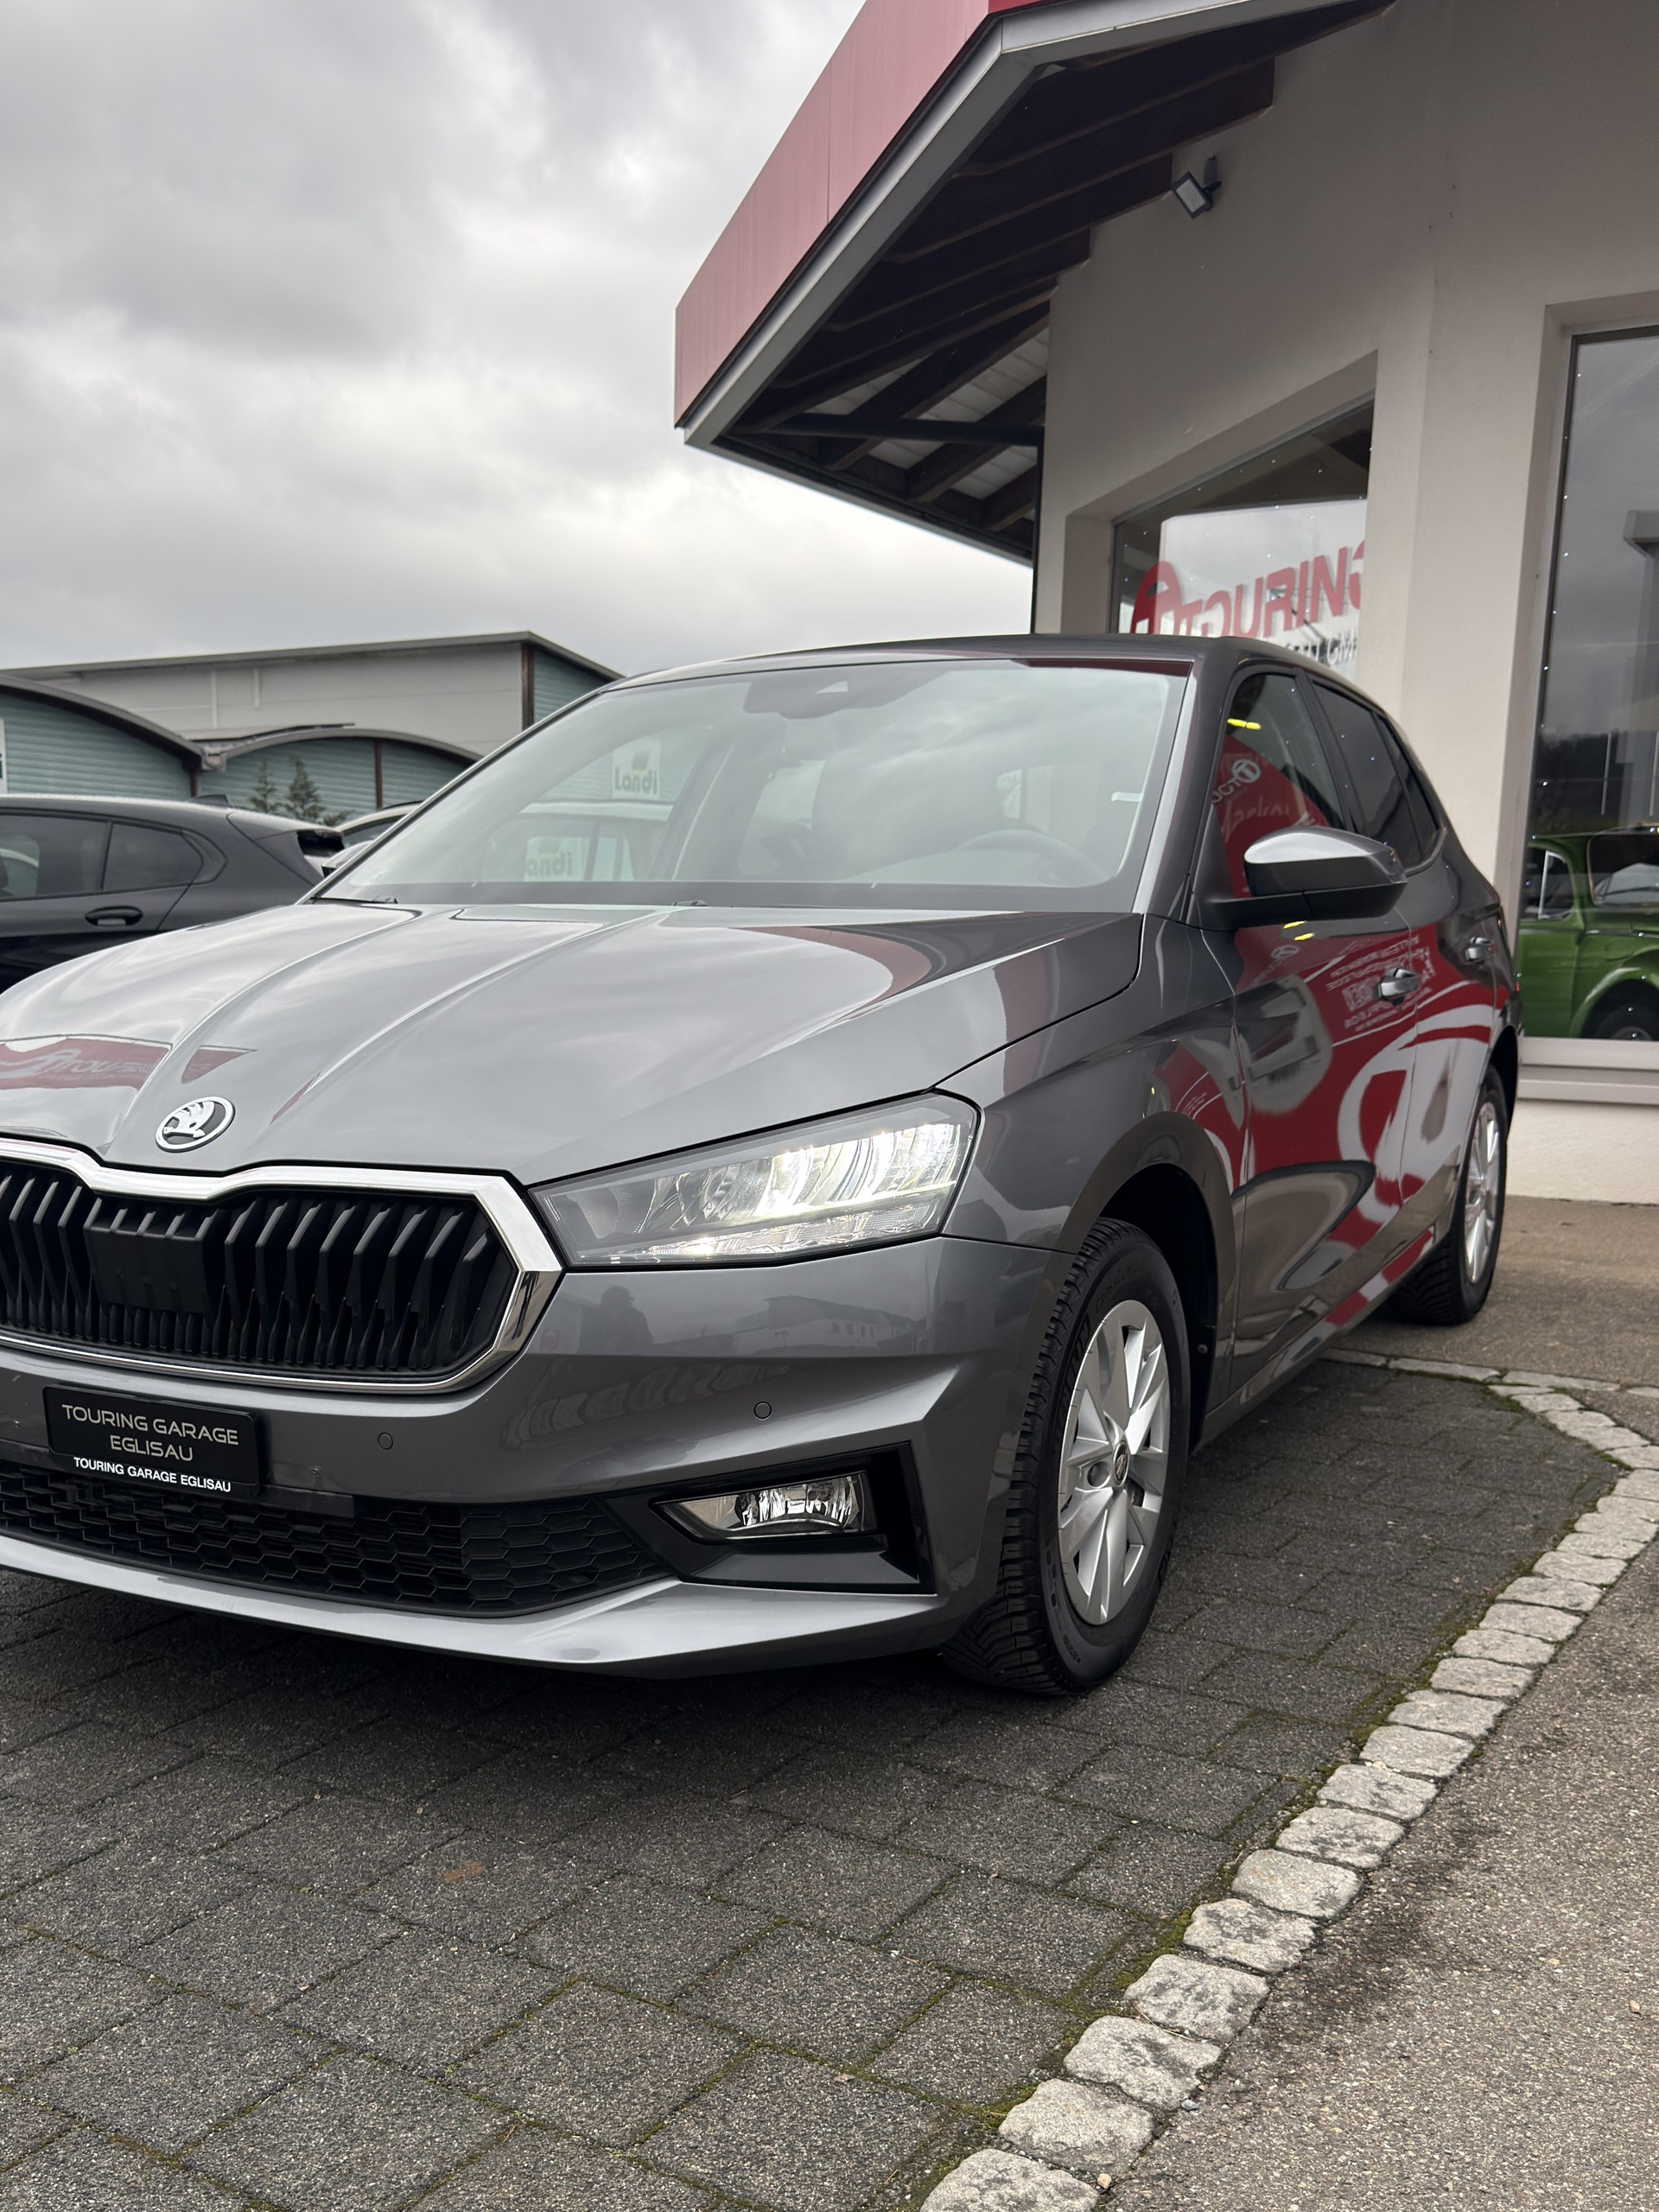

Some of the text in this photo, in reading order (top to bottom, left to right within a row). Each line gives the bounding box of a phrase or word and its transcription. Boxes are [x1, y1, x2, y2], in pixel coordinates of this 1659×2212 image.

[614, 766, 658, 796] Landi
[525, 851, 573, 877] andi
[61, 1403, 239, 1446] TOURING GARAGE
[110, 1434, 194, 1462] EGLISAU
[73, 1456, 232, 1493] TOURING GARAGE EGLISAU
